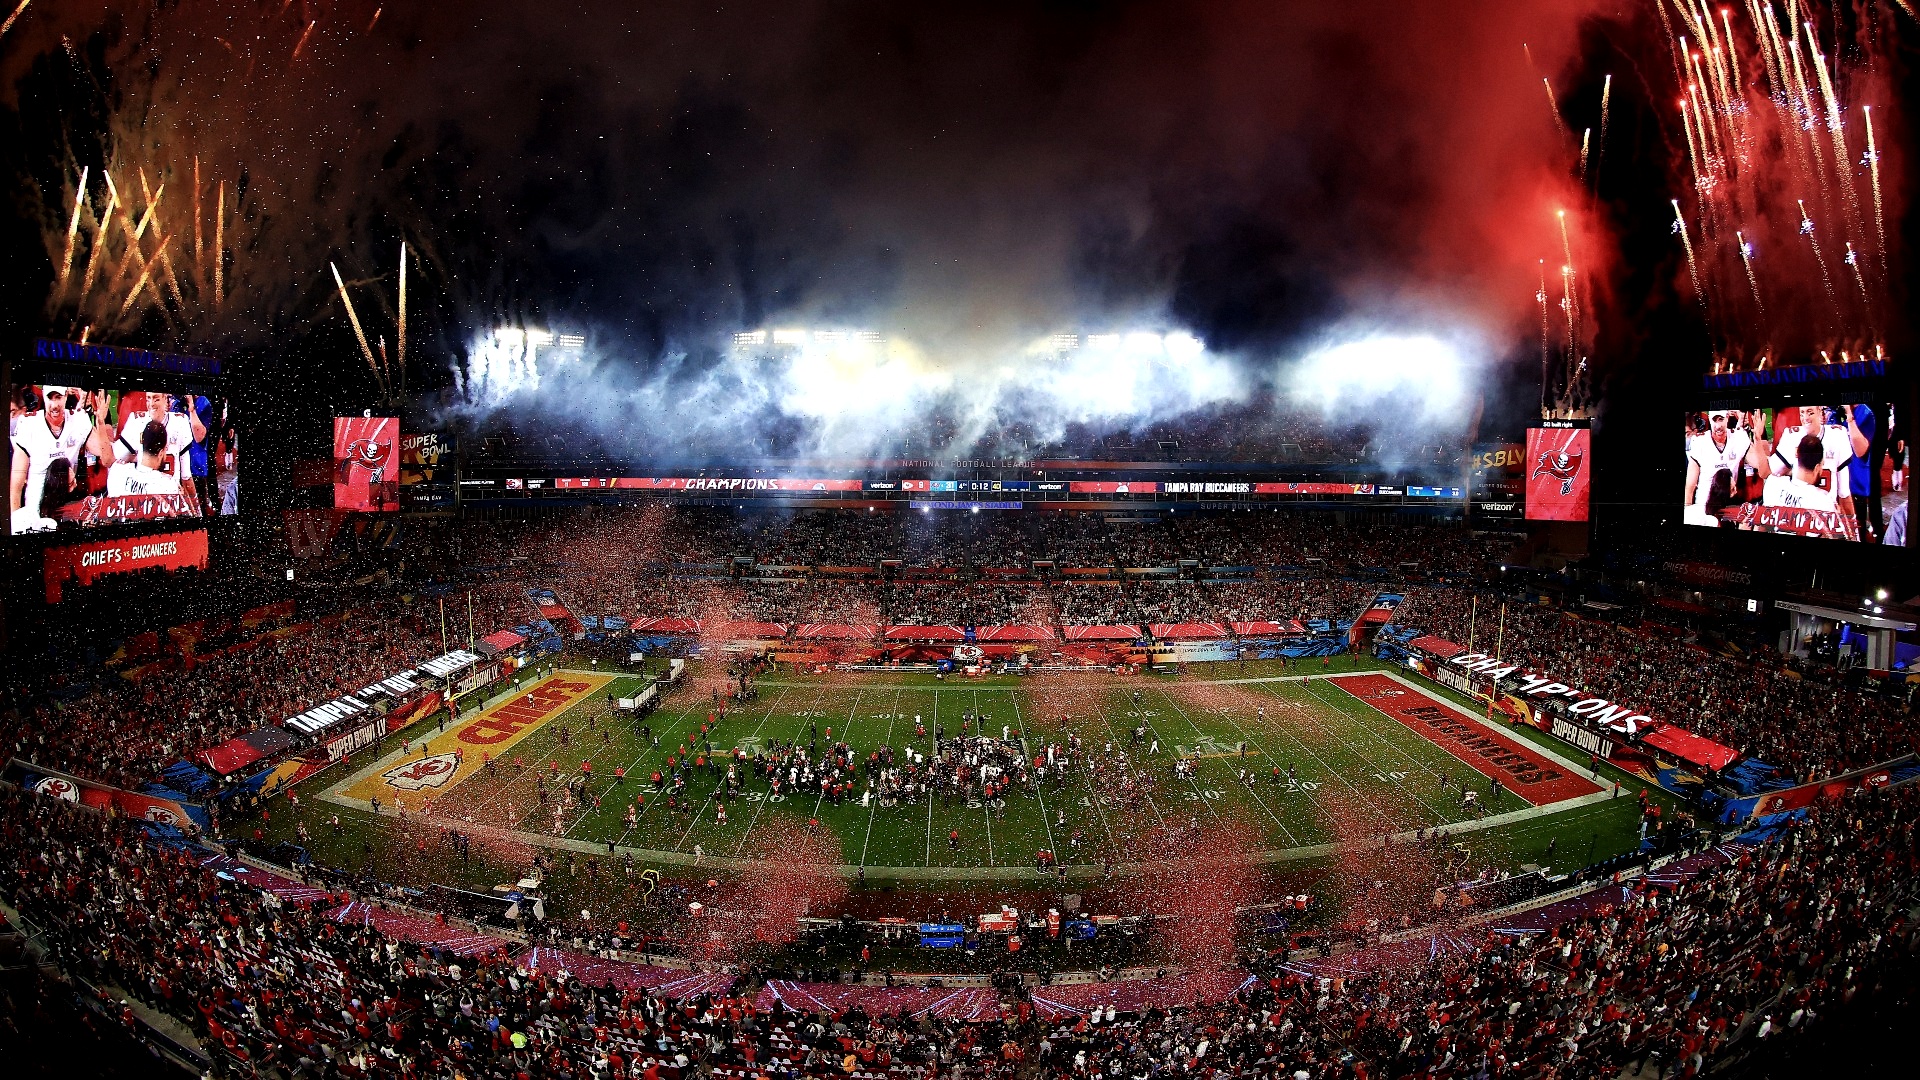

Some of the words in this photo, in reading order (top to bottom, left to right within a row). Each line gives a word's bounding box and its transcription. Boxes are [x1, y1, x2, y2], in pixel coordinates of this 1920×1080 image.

[36, 339, 115, 366] RAYMOND
[1704, 371, 1771, 389] RAYMOND
[1772, 364, 1819, 385] JAMES
[1820, 359, 1886, 380] STADIUM
[402, 433, 438, 450] SUPER
[422, 443, 451, 458] BOWL
[902, 460, 945, 468] NATIONAL
[1471, 448, 1526, 470] #SBLV
[124, 476, 148, 494] EVANS
[685, 478, 779, 490] CHAMPIONS
[971, 482, 989, 490] 0:12
[1164, 482, 1189, 493] TAMPA
[1190, 482, 1204, 493] BAY
[1204, 482, 1250, 493] BUCCANEERS
[911, 501, 954, 509] RAYMOND
[985, 502, 1022, 510] STADIUM
[1200, 502, 1228, 510] SUPER
[1481, 502, 1512, 511] verizon
[289, 519, 332, 558] LV
[82, 548, 122, 567] CHIEFS
[131, 541, 177, 560] BUCCANEERS
[1662, 560, 1689, 576] CHIEFS
[1698, 565, 1752, 585] BUCCANEERS
[456, 676, 475, 693] SUPER
[475, 668, 492, 688] BOWL
[491, 664, 498, 680] LV
[1436, 666, 1454, 687] SUPER
[1455, 674, 1471, 692] BOWL
[1450, 652, 1652, 734] CHAMPIONS
[286, 698, 359, 734] TAMPA
[457, 678, 593, 745] CHIEFS
[327, 733, 354, 762] SUPER
[354, 723, 376, 749] BOWL
[376, 717, 386, 737] LV
[1399, 705, 1565, 786] BUCCANEERS
[1552, 717, 1577, 744] SUPER
[1577, 728, 1601, 753] BOWL
[1601, 741, 1614, 759] LV
[1281, 782, 1319, 794] 20
[1371, 770, 1407, 783] 10
